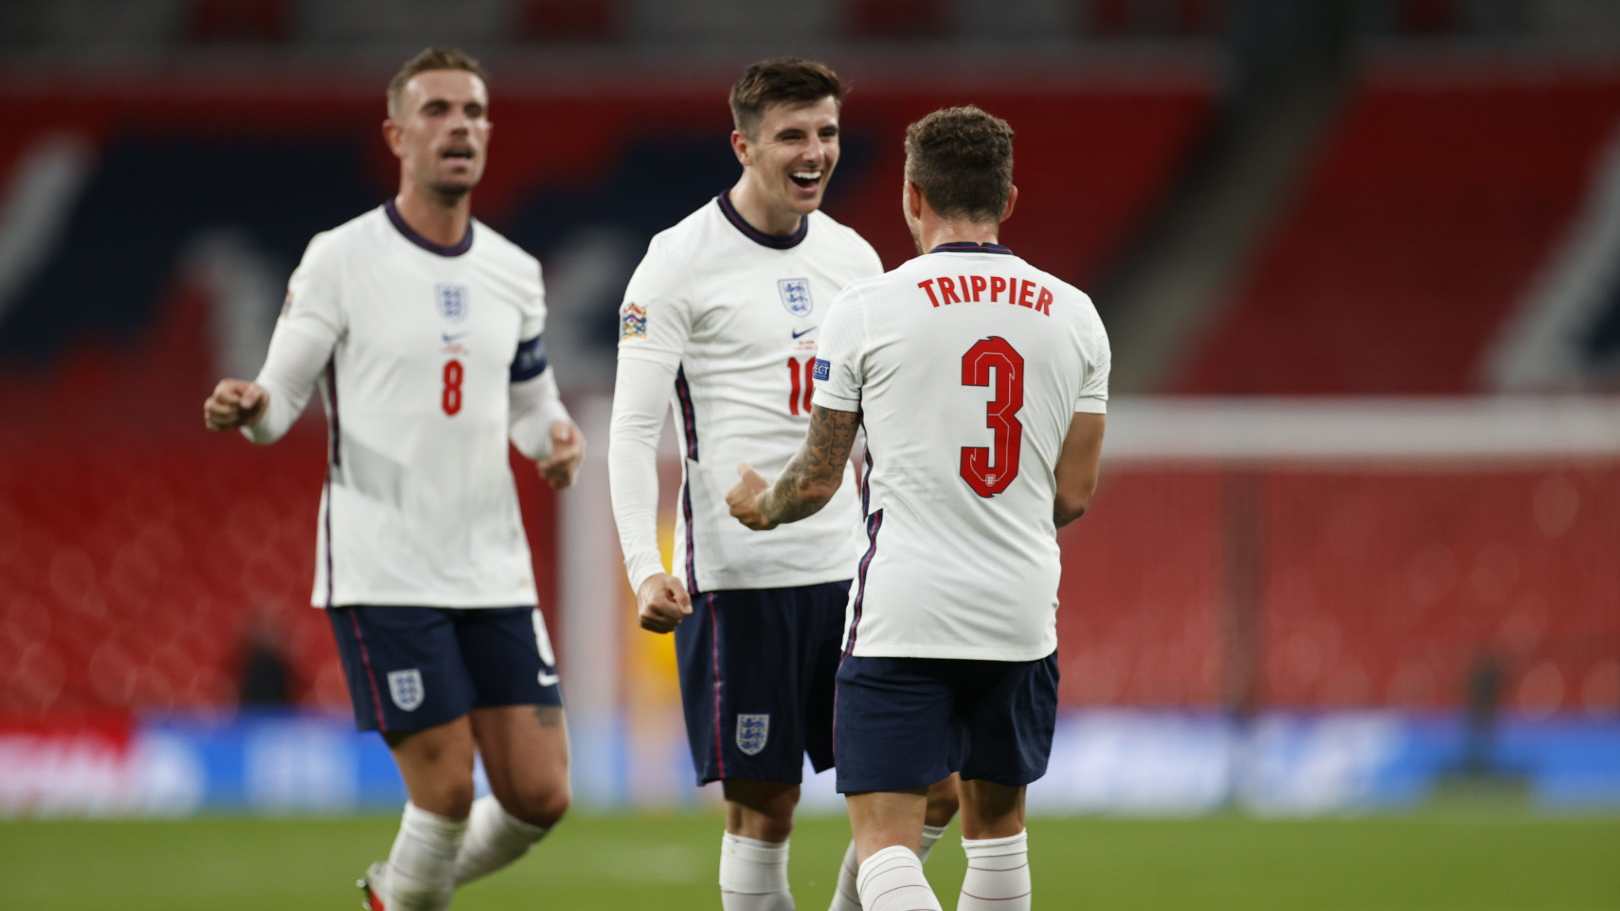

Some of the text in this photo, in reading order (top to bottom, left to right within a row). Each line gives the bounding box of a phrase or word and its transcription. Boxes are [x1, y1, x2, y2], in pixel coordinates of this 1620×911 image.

[917, 275, 1054, 317] TRIPPIER
[442, 359, 464, 416] 8
[960, 336, 1025, 498] 3
